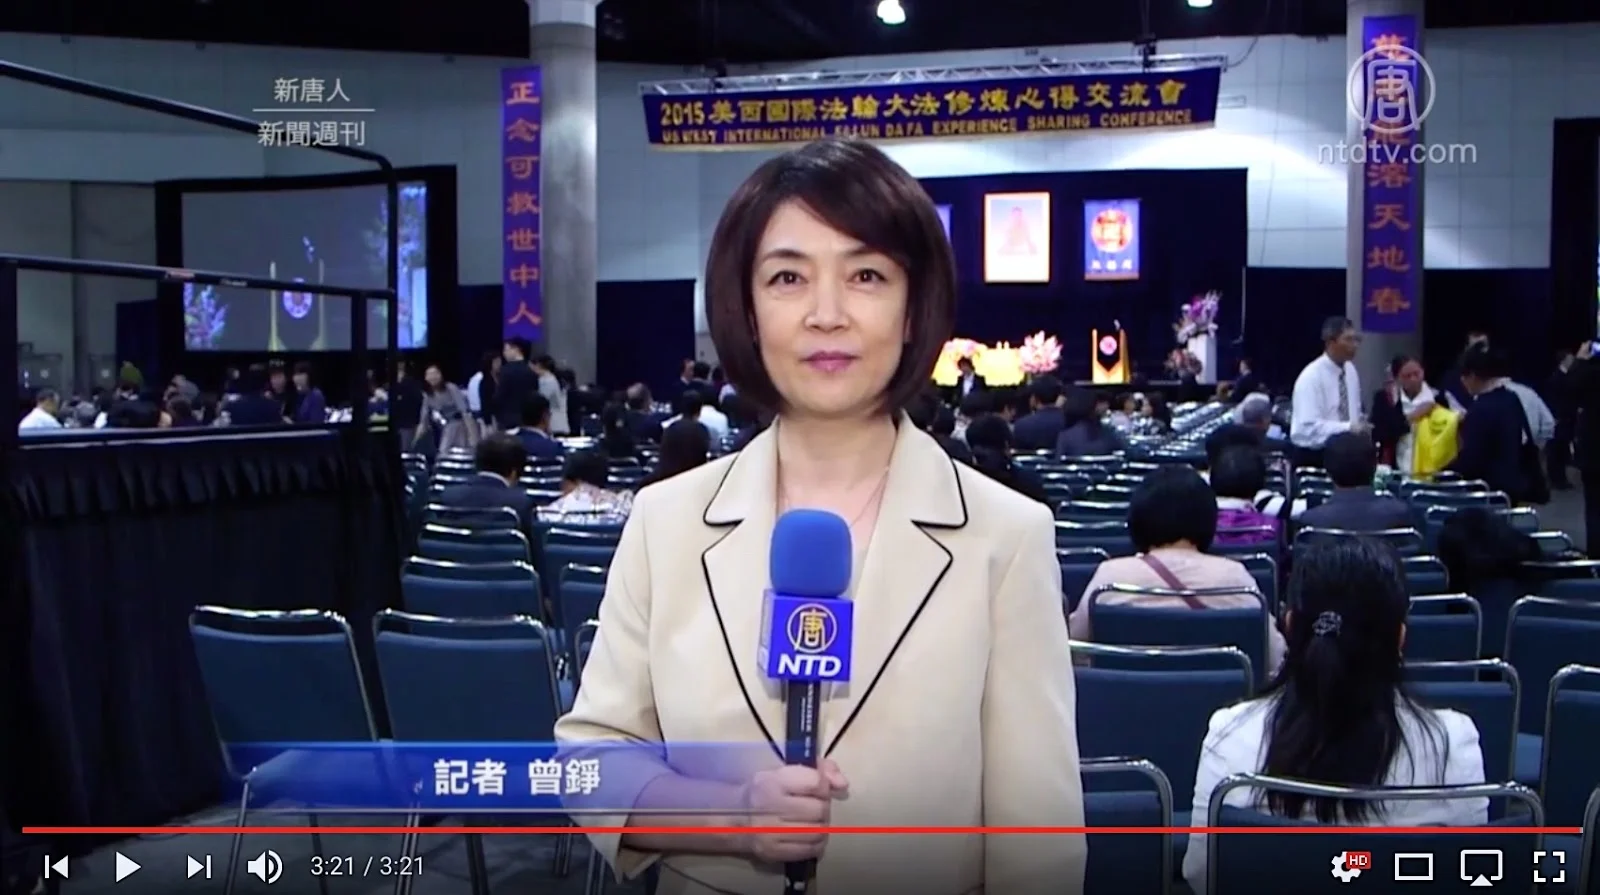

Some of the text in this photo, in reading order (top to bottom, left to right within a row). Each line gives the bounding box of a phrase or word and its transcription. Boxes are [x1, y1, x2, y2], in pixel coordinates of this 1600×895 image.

[682, 129, 717, 143] WEST
[723, 124, 826, 142] INTERNATIONAL
[932, 117, 1017, 135] EXPERIENCE
[1027, 113, 1090, 130] SHARING
[1100, 109, 1192, 127] CONFERENCE
[505, 81, 542, 326] 正念可救世中人
[777, 652, 842, 677] NTD
